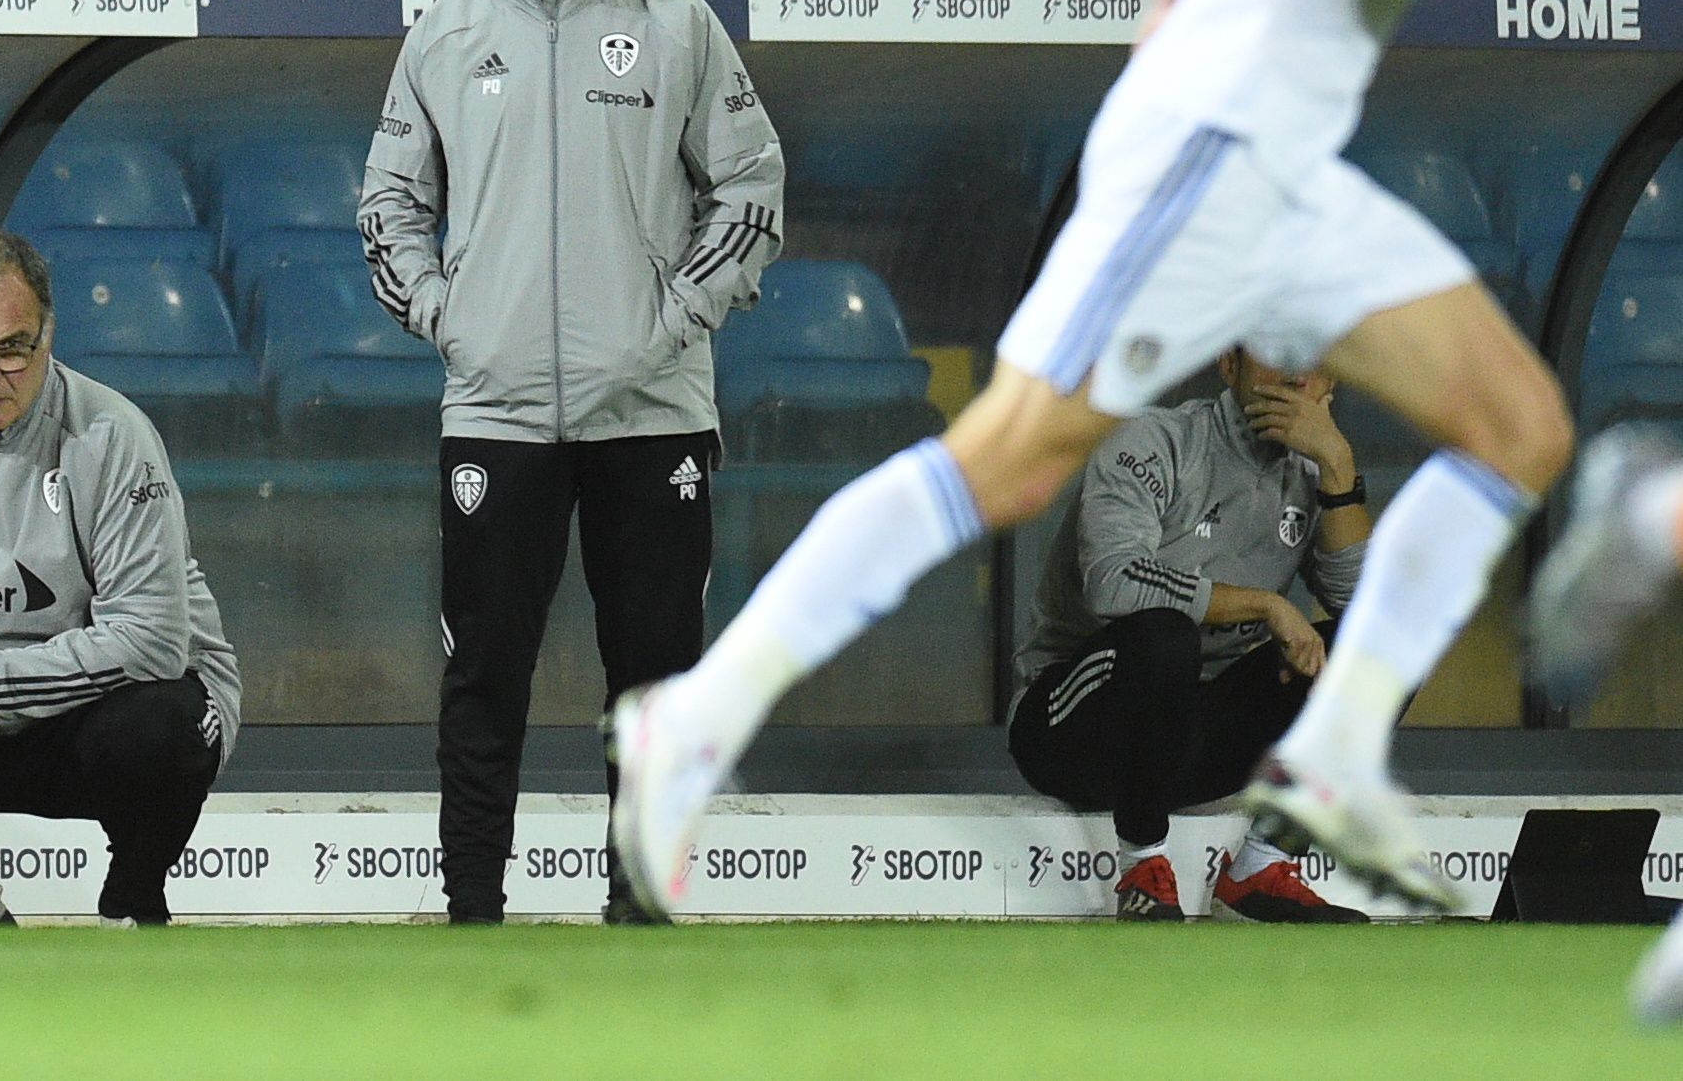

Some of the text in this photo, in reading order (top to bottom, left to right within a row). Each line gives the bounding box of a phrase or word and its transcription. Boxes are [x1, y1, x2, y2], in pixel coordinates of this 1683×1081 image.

[585, 89, 642, 107] Clipper
[707, 848, 807, 880] SBOTOP
[884, 850, 983, 881] SBOTOP
[1061, 850, 1119, 882] SBO
